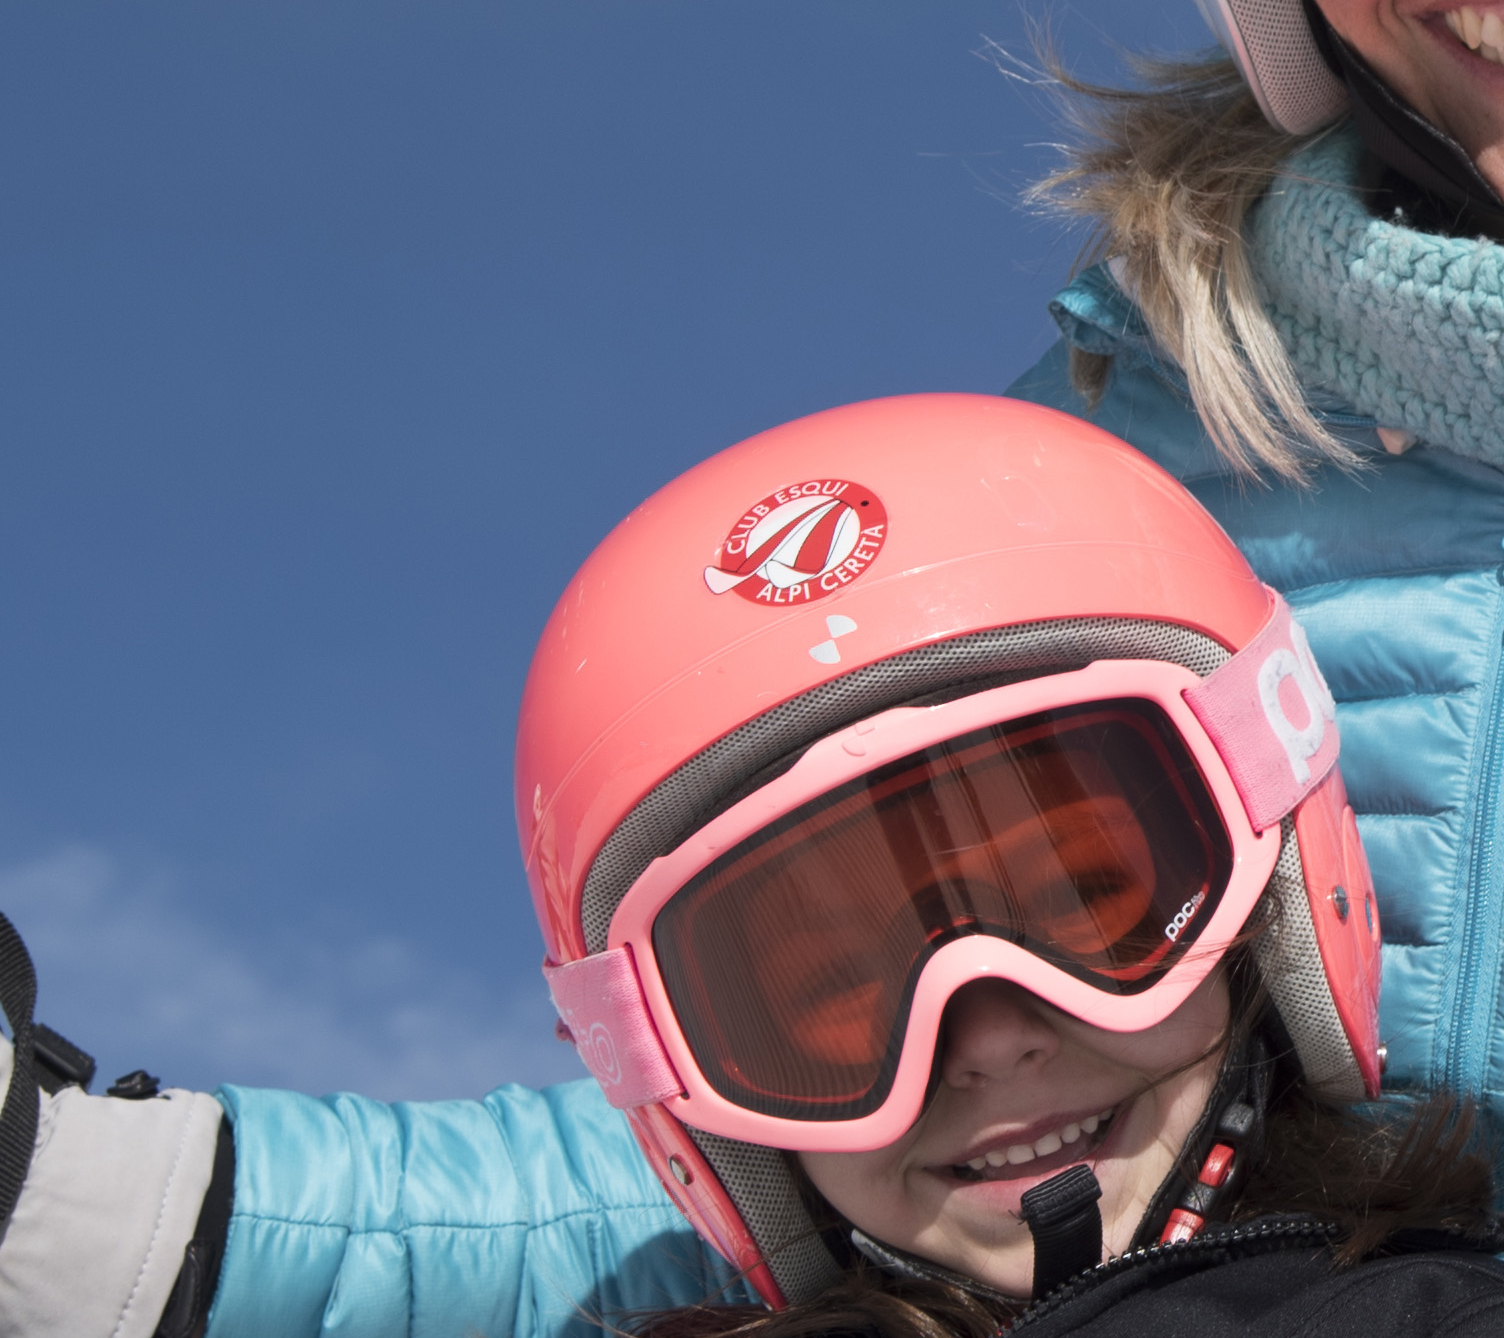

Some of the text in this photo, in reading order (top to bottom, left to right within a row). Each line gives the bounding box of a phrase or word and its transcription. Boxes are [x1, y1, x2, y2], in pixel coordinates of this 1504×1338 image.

[726, 481, 849, 555] CLUB ESQUI
[756, 582, 811, 603] ALPI
